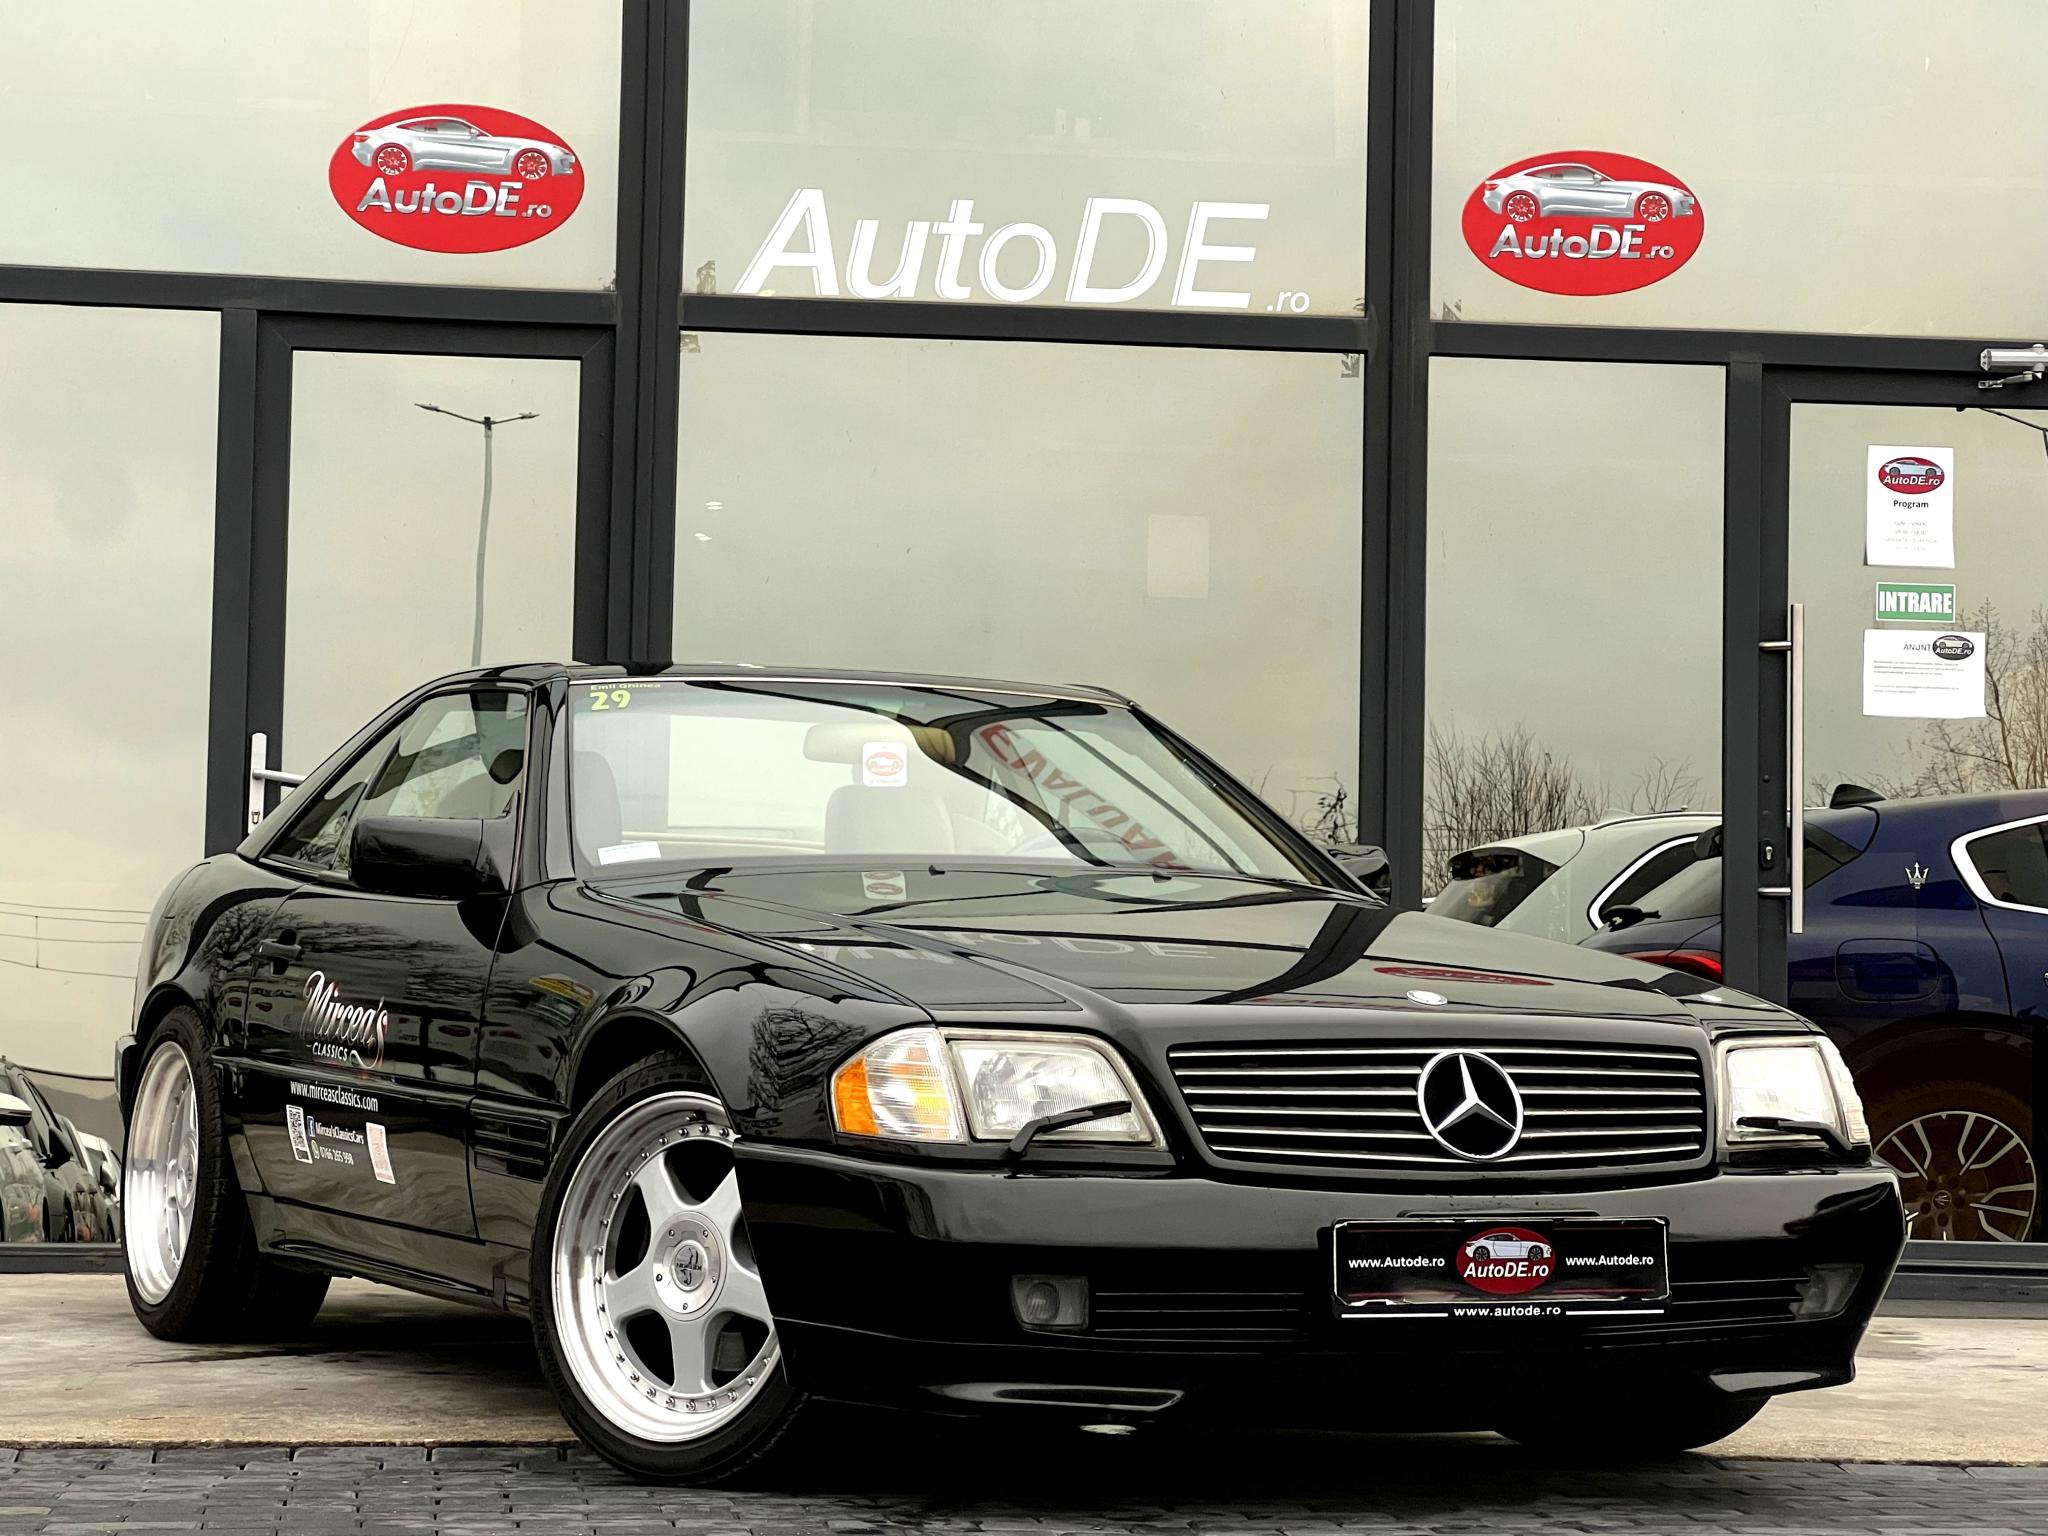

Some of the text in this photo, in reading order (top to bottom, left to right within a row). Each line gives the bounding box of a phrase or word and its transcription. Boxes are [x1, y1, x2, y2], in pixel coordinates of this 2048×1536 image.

[356, 177, 553, 218] AutoDE.ro
[1488, 223, 1675, 260] AutoDE.ro
[1883, 476, 1941, 486] AutoDE.ro
[1893, 500, 1929, 509] Program
[1879, 591, 1953, 614] INTRARE
[1935, 647, 1972, 656] AutoDE.ro
[590, 689, 631, 711] 29
[301, 970, 388, 1068] Mircea's
[312, 1042, 348, 1061] CLASSICS
[290, 1080, 379, 1112] www.mirceasclassics.com
[1349, 1255, 1446, 1269] www.Autode.ro
[1565, 1254, 1655, 1267] www.Autode.ro
[1463, 1262, 1549, 1278] AutoDE.ro
[1454, 1305, 1562, 1317] www.autode.ro
